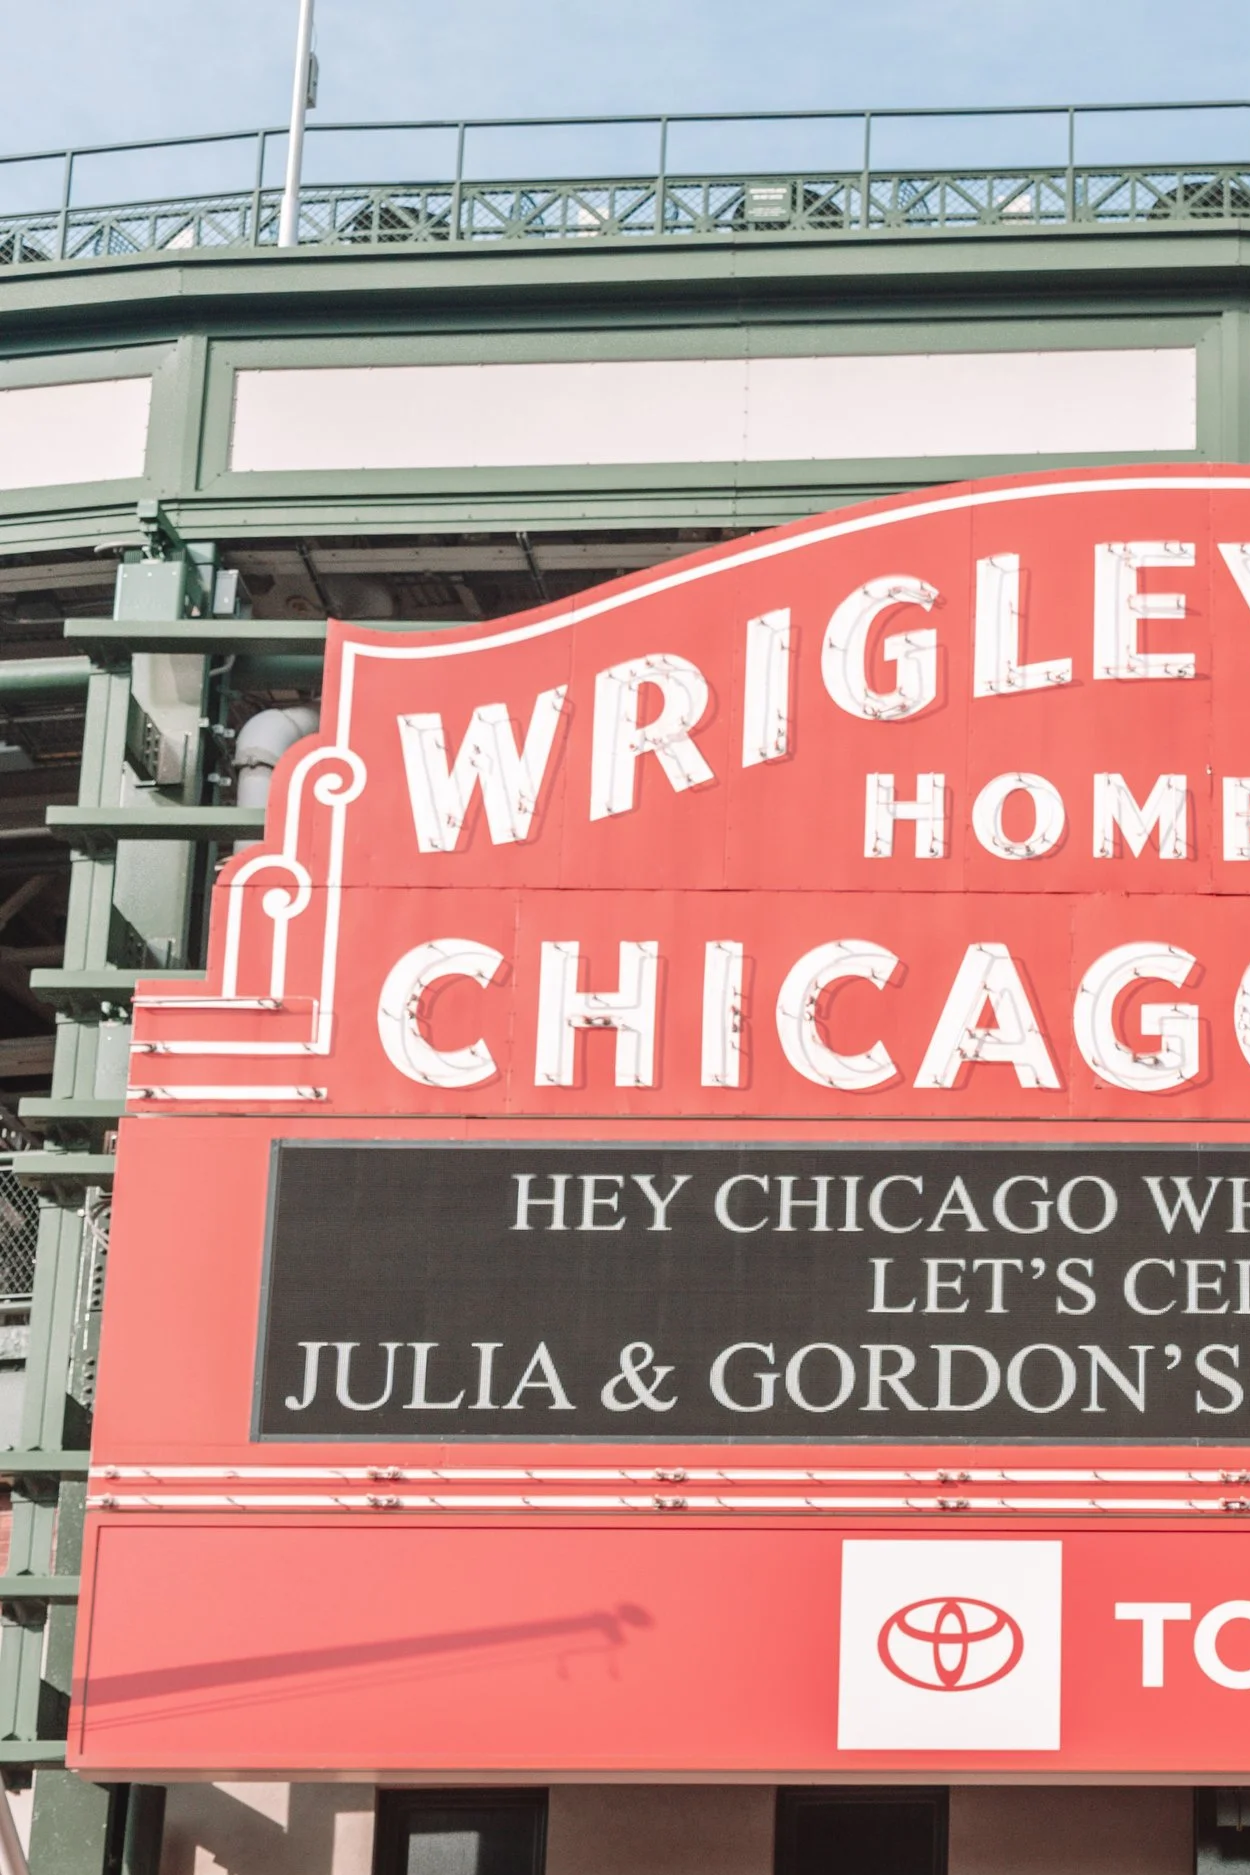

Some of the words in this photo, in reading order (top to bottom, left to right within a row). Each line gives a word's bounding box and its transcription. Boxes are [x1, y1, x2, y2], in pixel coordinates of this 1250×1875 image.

[511, 1174, 692, 1231] HEY
[714, 1174, 1118, 1235] CHICAGO
[867, 1257, 1096, 1316] LET'S
[284, 1341, 577, 1411] JULIA
[600, 1341, 678, 1412] &
[709, 1342, 1244, 1415] GORDON'S
